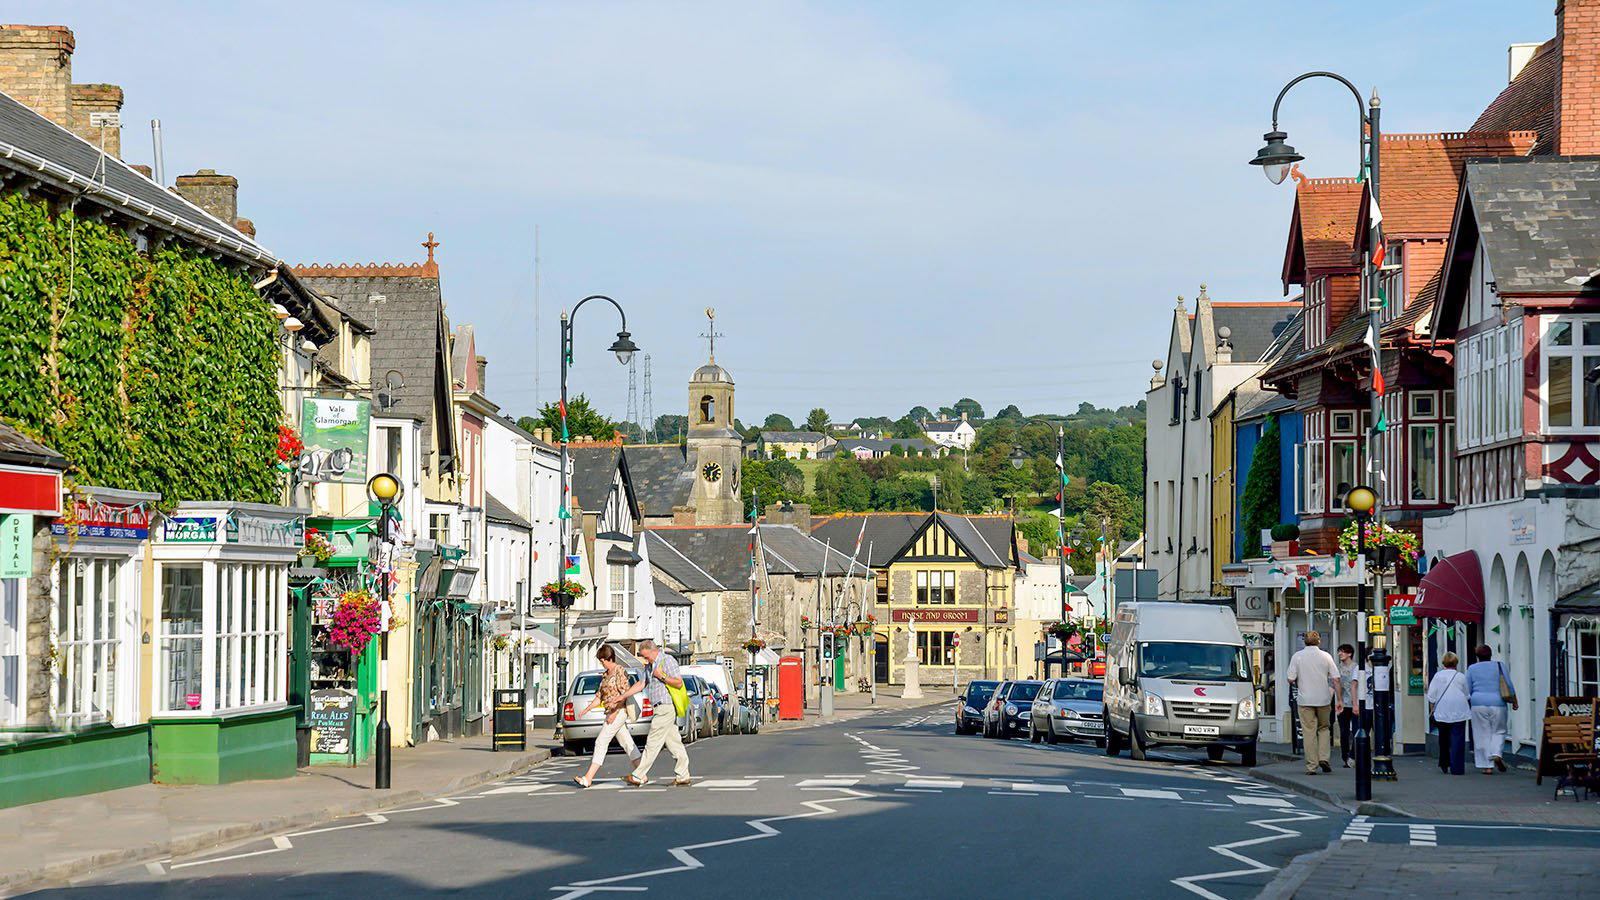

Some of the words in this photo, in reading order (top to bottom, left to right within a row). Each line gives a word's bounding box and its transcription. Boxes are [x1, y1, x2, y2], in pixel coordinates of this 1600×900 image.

[329, 405, 345, 413] Vale
[314, 416, 357, 427] Glamorgan
[166, 531, 216, 540] MORGAN
[901, 612, 924, 621] HORSE
[926, 611, 941, 620] AND
[943, 612, 968, 620] GROOM
[1371, 617, 1382, 631] H
